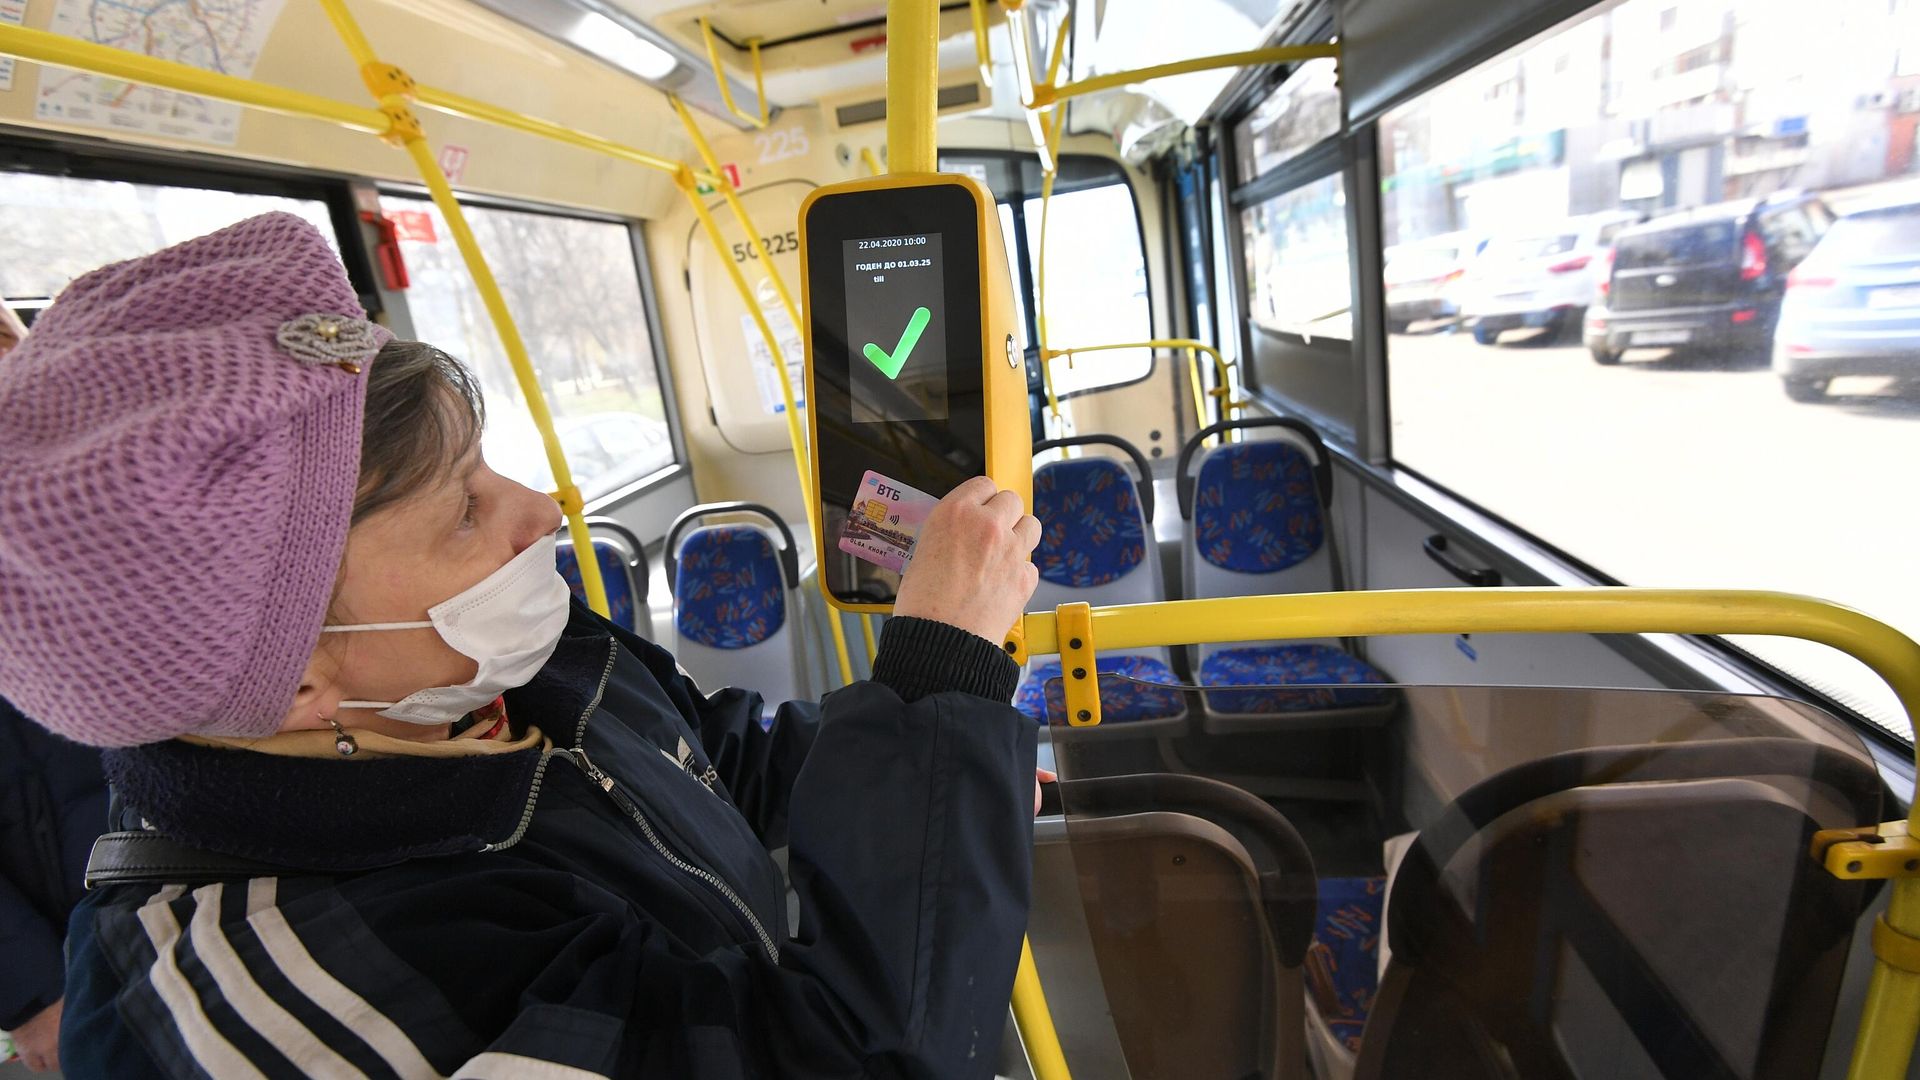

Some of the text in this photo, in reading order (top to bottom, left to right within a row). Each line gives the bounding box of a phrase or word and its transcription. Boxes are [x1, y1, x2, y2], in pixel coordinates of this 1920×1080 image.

[755, 127, 809, 164] 225
[859, 237, 926, 249] 22.04.2020 10:00
[856, 259, 931, 271] ГОДЕН ДО 01.03.25
[873, 275, 884, 283] till
[877, 484, 901, 501] ВТБ
[849, 538, 865, 548] OLGA
[868, 545, 887, 557] KHORT
